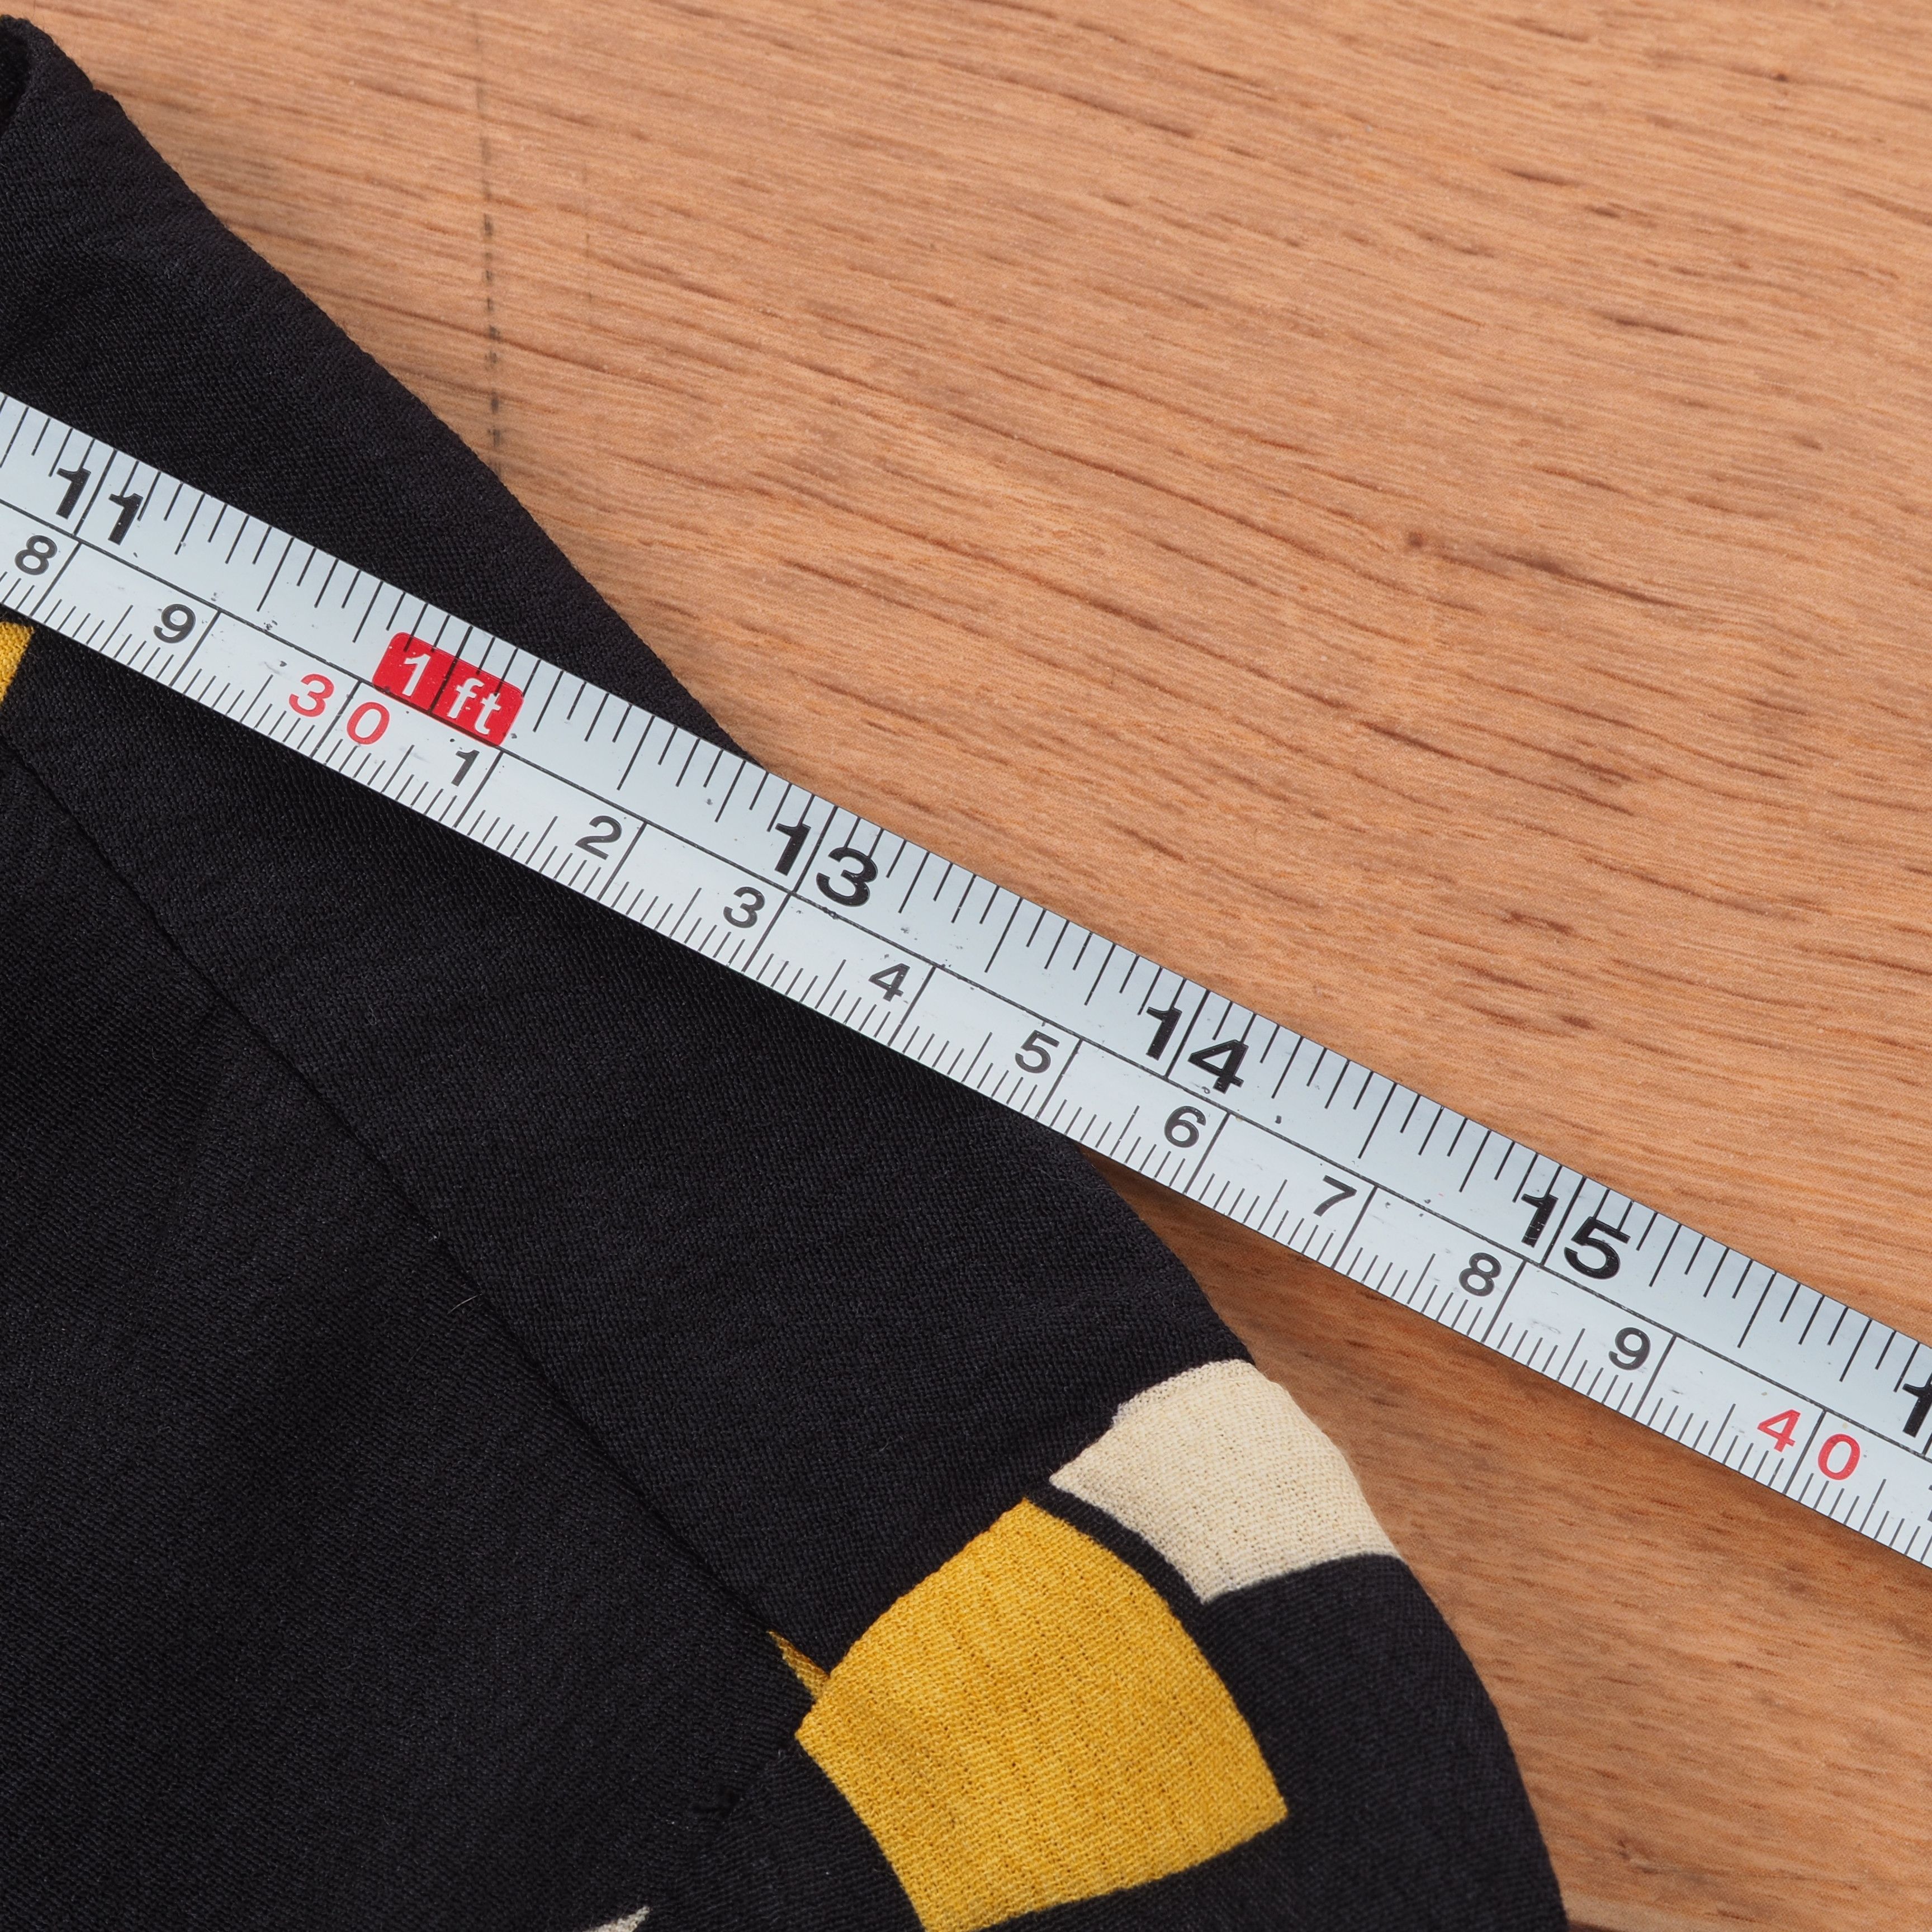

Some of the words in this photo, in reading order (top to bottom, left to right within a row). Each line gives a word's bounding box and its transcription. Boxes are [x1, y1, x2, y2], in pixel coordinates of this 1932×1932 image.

[56, 468, 144, 546] 11
[15, 534, 58, 576] 8
[154, 604, 196, 644] 9
[288, 674, 390, 745] 30
[402, 654, 432, 698] 1
[449, 678, 502, 736] ft
[451, 749, 480, 787] 1
[575, 816, 622, 860] 2
[774, 821, 878, 907] 13
[723, 887, 766, 929] 3
[869, 963, 911, 1002] 4
[1015, 1030, 1059, 1074] 5
[1147, 1006, 1249, 1093] 14
[1164, 1105, 1207, 1148] 6
[1314, 1176, 1357, 1217] 7
[1521, 1192, 1631, 1280] 15
[1459, 1252, 1502, 1297] 8
[1608, 1327, 1651, 1371] 9
[1757, 1409, 1862, 1481] 40
